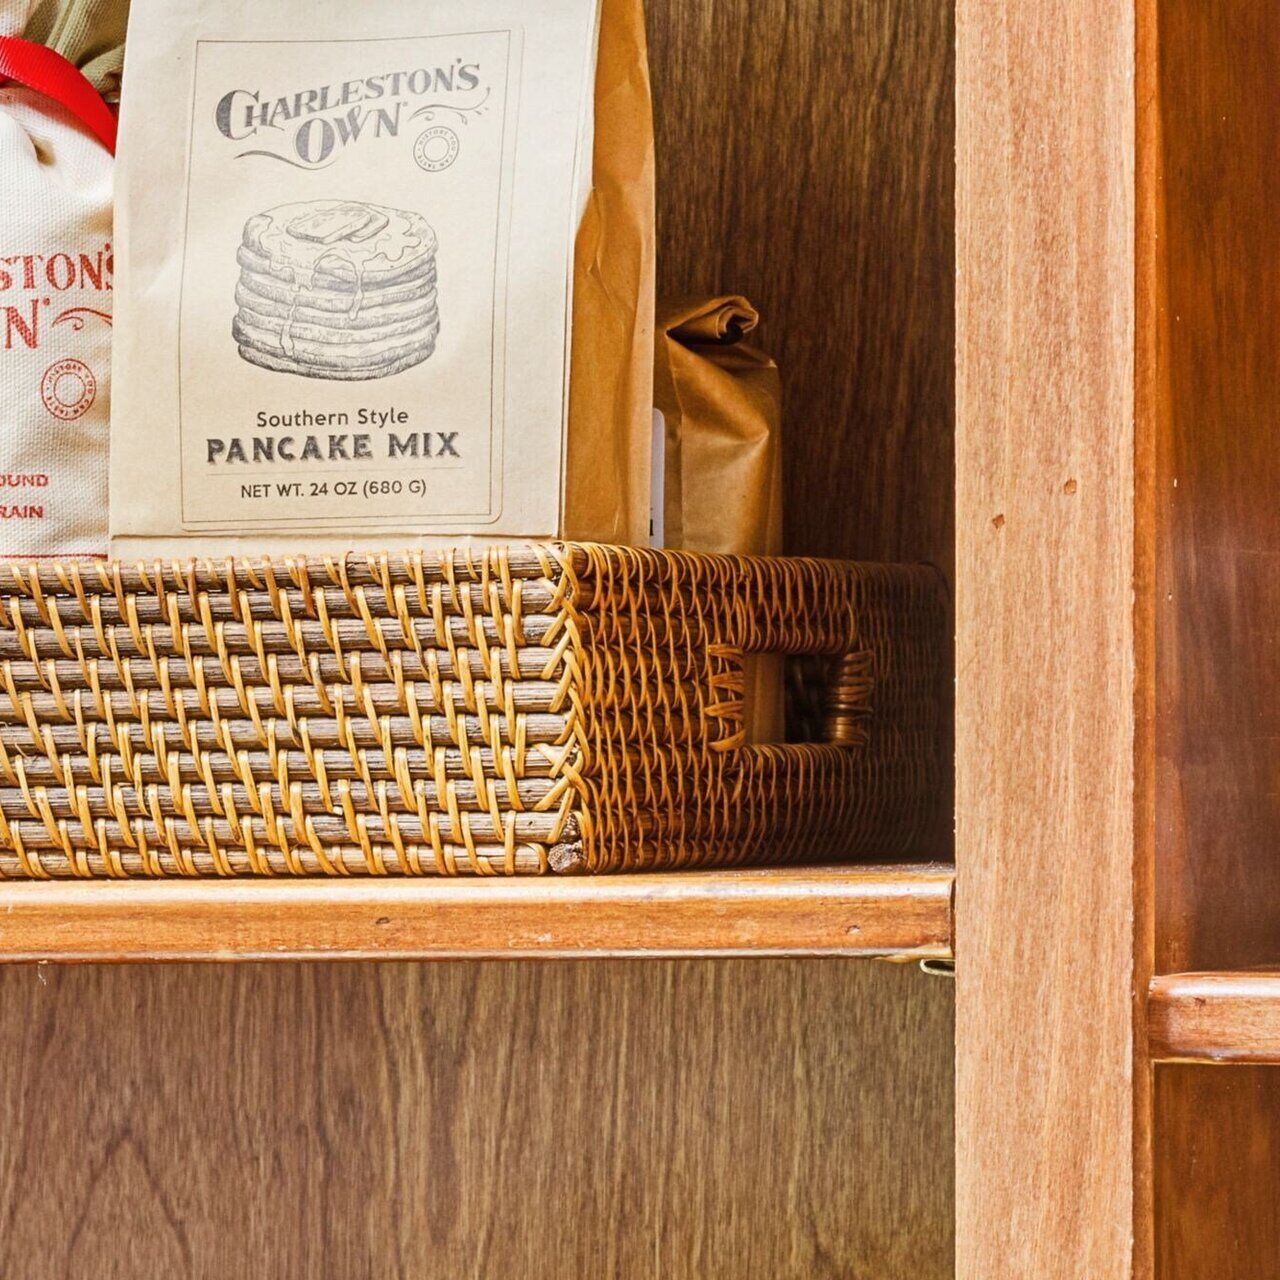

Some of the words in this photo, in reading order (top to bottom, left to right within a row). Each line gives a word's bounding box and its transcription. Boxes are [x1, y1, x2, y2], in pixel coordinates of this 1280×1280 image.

[215, 58, 480, 141] CHARLESTON'S
[295, 102, 401, 163] OWN
[256, 410, 349, 428] Southern
[358, 407, 409, 426] Style
[206, 432, 373, 465] PANCAKE
[388, 431, 461, 459] MIX
[240, 483, 272, 499] NET
[276, 481, 305, 497] WT.
[309, 481, 328, 497] 24
[333, 480, 358, 496] OZ
[363, 480, 403, 499] (680
[408, 479, 427, 498] G)
